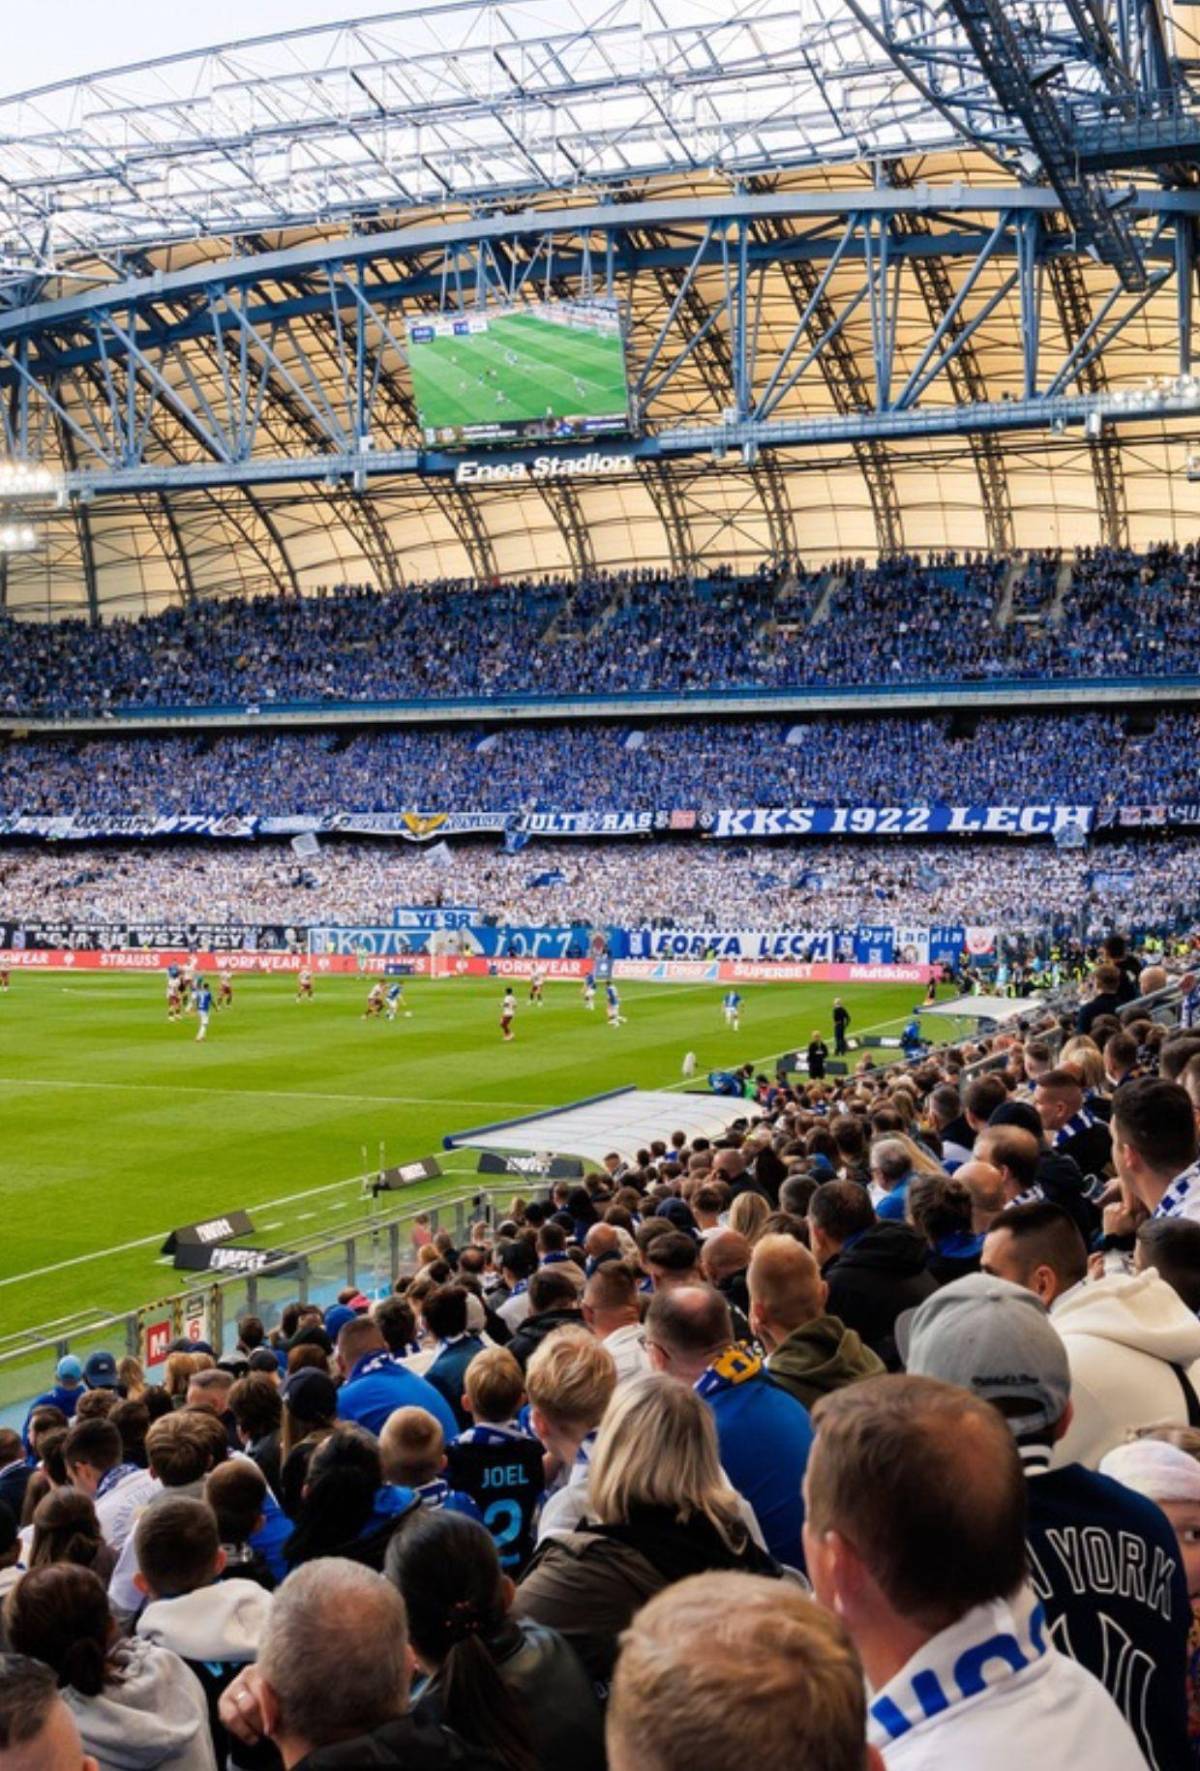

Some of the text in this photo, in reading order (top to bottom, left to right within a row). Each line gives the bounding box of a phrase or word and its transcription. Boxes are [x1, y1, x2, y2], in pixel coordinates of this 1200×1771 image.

[456, 452, 634, 484] Enea Stadion
[713, 806, 1093, 836] KKS 1922 LECH
[656, 935, 829, 956] FORZA LECH
[100, 953, 160, 967] STRAUSS
[215, 955, 300, 969] WORKWEAR
[733, 965, 813, 979] SUPERBET
[850, 967, 921, 979] Multikino
[189, 1319, 200, 1343] 6
[481, 1464, 529, 1488] JOEL
[484, 1499, 523, 1568] 2
[1045, 1526, 1176, 1622] YORK
